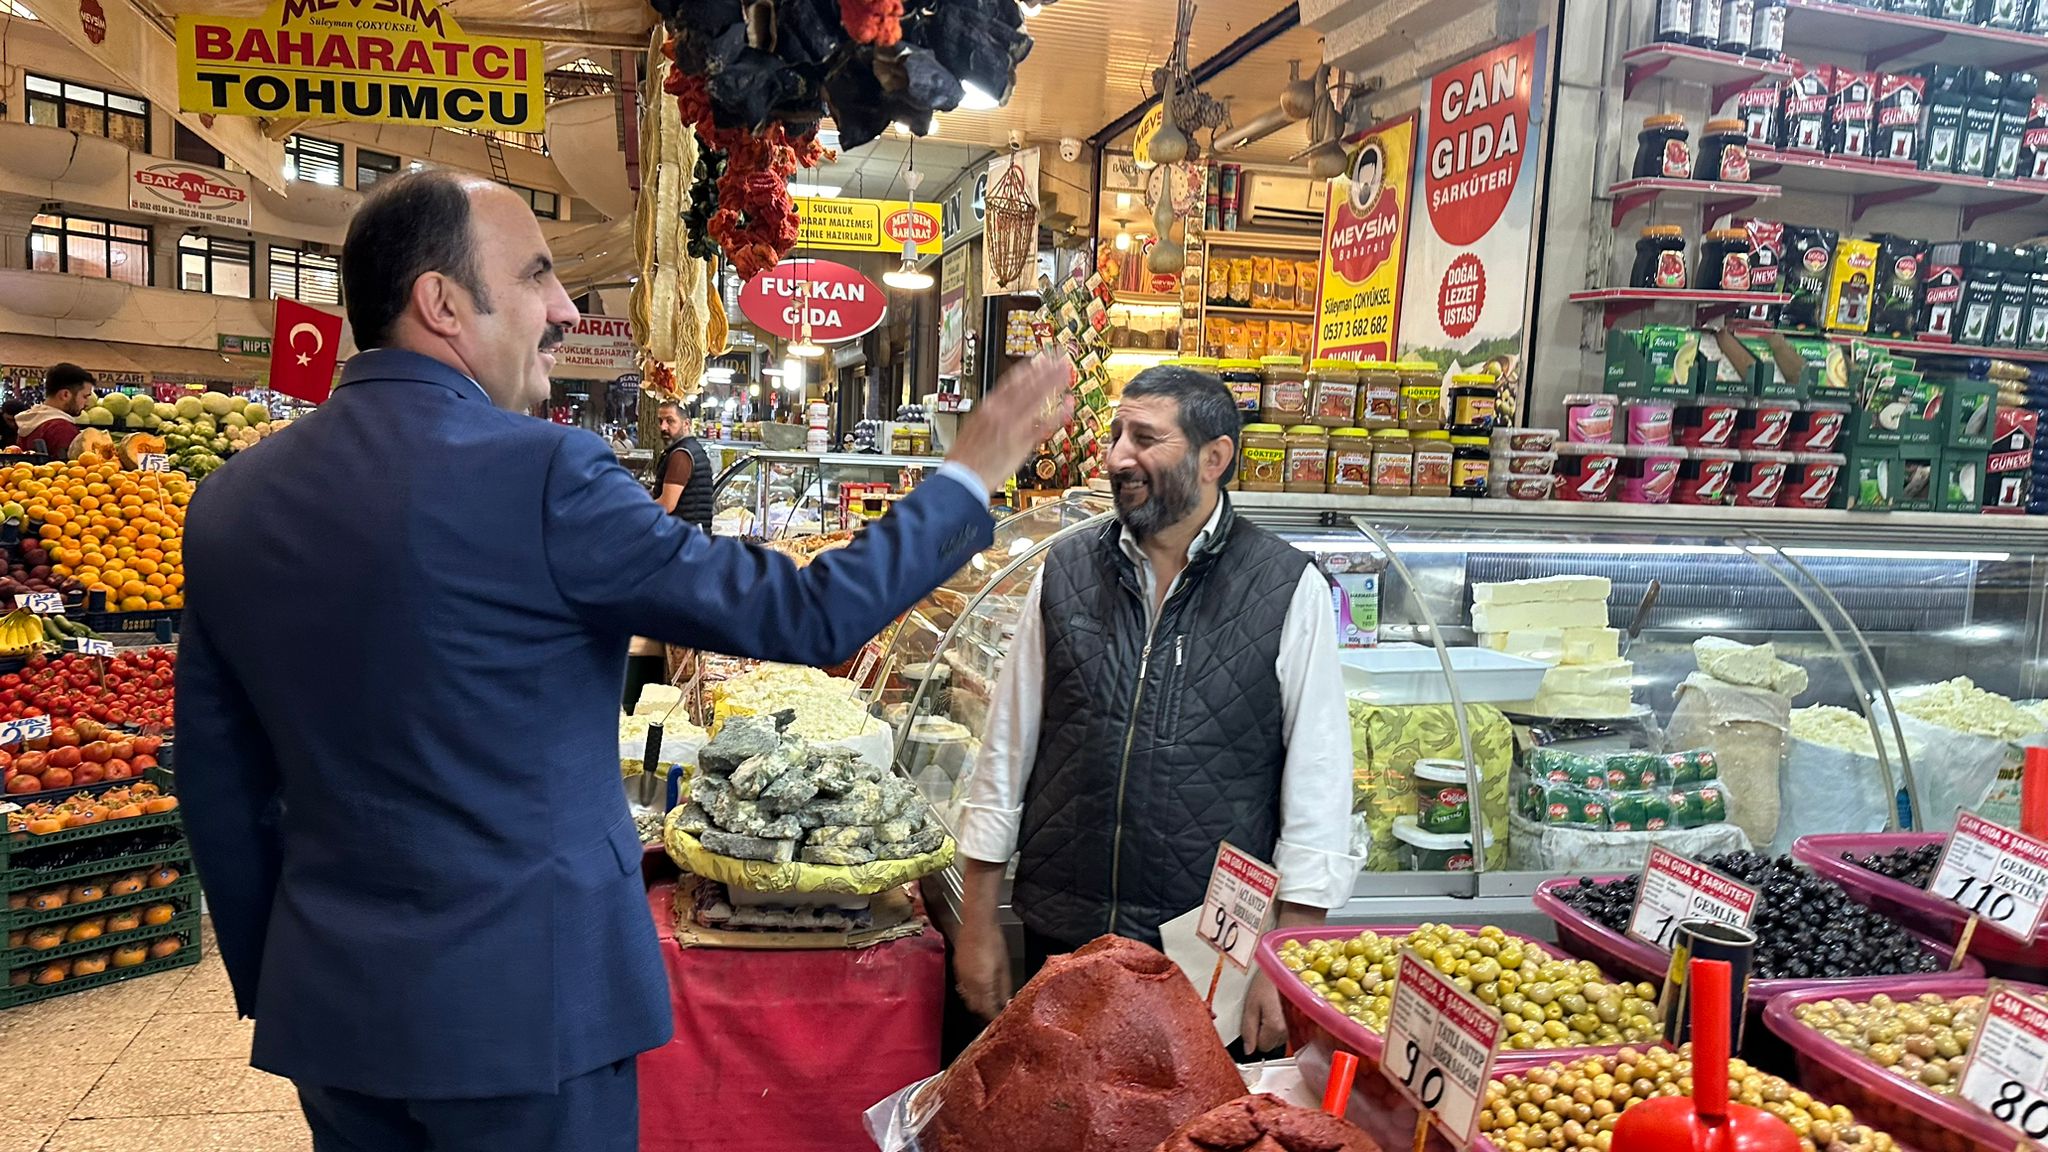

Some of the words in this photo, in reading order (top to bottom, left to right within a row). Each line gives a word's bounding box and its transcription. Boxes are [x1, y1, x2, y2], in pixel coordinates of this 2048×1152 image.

[356, 18, 418, 33] ÇOKYÜKSEL
[194, 24, 527, 82] BAHARATCI
[197, 72, 528, 126] TOHUMCU
[1441, 54, 1518, 123] CAN
[1431, 112, 1519, 180] GIDA
[140, 173, 240, 200] BAKANLAR
[1433, 161, 1513, 212] ŞARKÜTERİ
[813, 204, 853, 215] SUCUKLUK
[829, 218, 873, 229] MALZEMESİ
[1331, 212, 1396, 250] MEVSİM
[826, 232, 873, 242] HAZIRLANIR
[1339, 240, 1384, 261] Baharat
[1447, 262, 1479, 286] DOĞAL
[761, 277, 865, 302] FURKAN
[1445, 284, 1479, 306] LEZZET
[782, 306, 842, 327] GIDA
[1443, 304, 1477, 326] USTASI
[1323, 322, 1344, 340] 0537
[1345, 320, 1351, 338] 3
[1352, 318, 1368, 337] 682
[1370, 315, 1388, 335] 682
[565, 356, 614, 366] HAZIRLANIR
[594, 347, 631, 358] BAHARAT
[100, 372, 144, 383] PAZARI
[1989, 452, 2032, 471] GÜNEYCE
[83, 638, 106, 655] 15
[1, 724, 45, 743] 25
[1961, 816, 1979, 831] CAN
[1980, 822, 2001, 841] GIDA
[2002, 832, 2010, 843] &
[1652, 851, 1670, 867] CAN
[1670, 860, 1691, 877] GIDA
[1691, 869, 1700, 881] &
[1700, 873, 1751, 905] ŞARKÜTERİ
[1693, 896, 1740, 925] GEMLİK
[1946, 876, 2015, 921] 110
[1210, 907, 1239, 952] 90
[1994, 993, 2022, 1016] CAN
[1399, 1040, 1445, 1109] 90
[1991, 1081, 2048, 1140] 80
